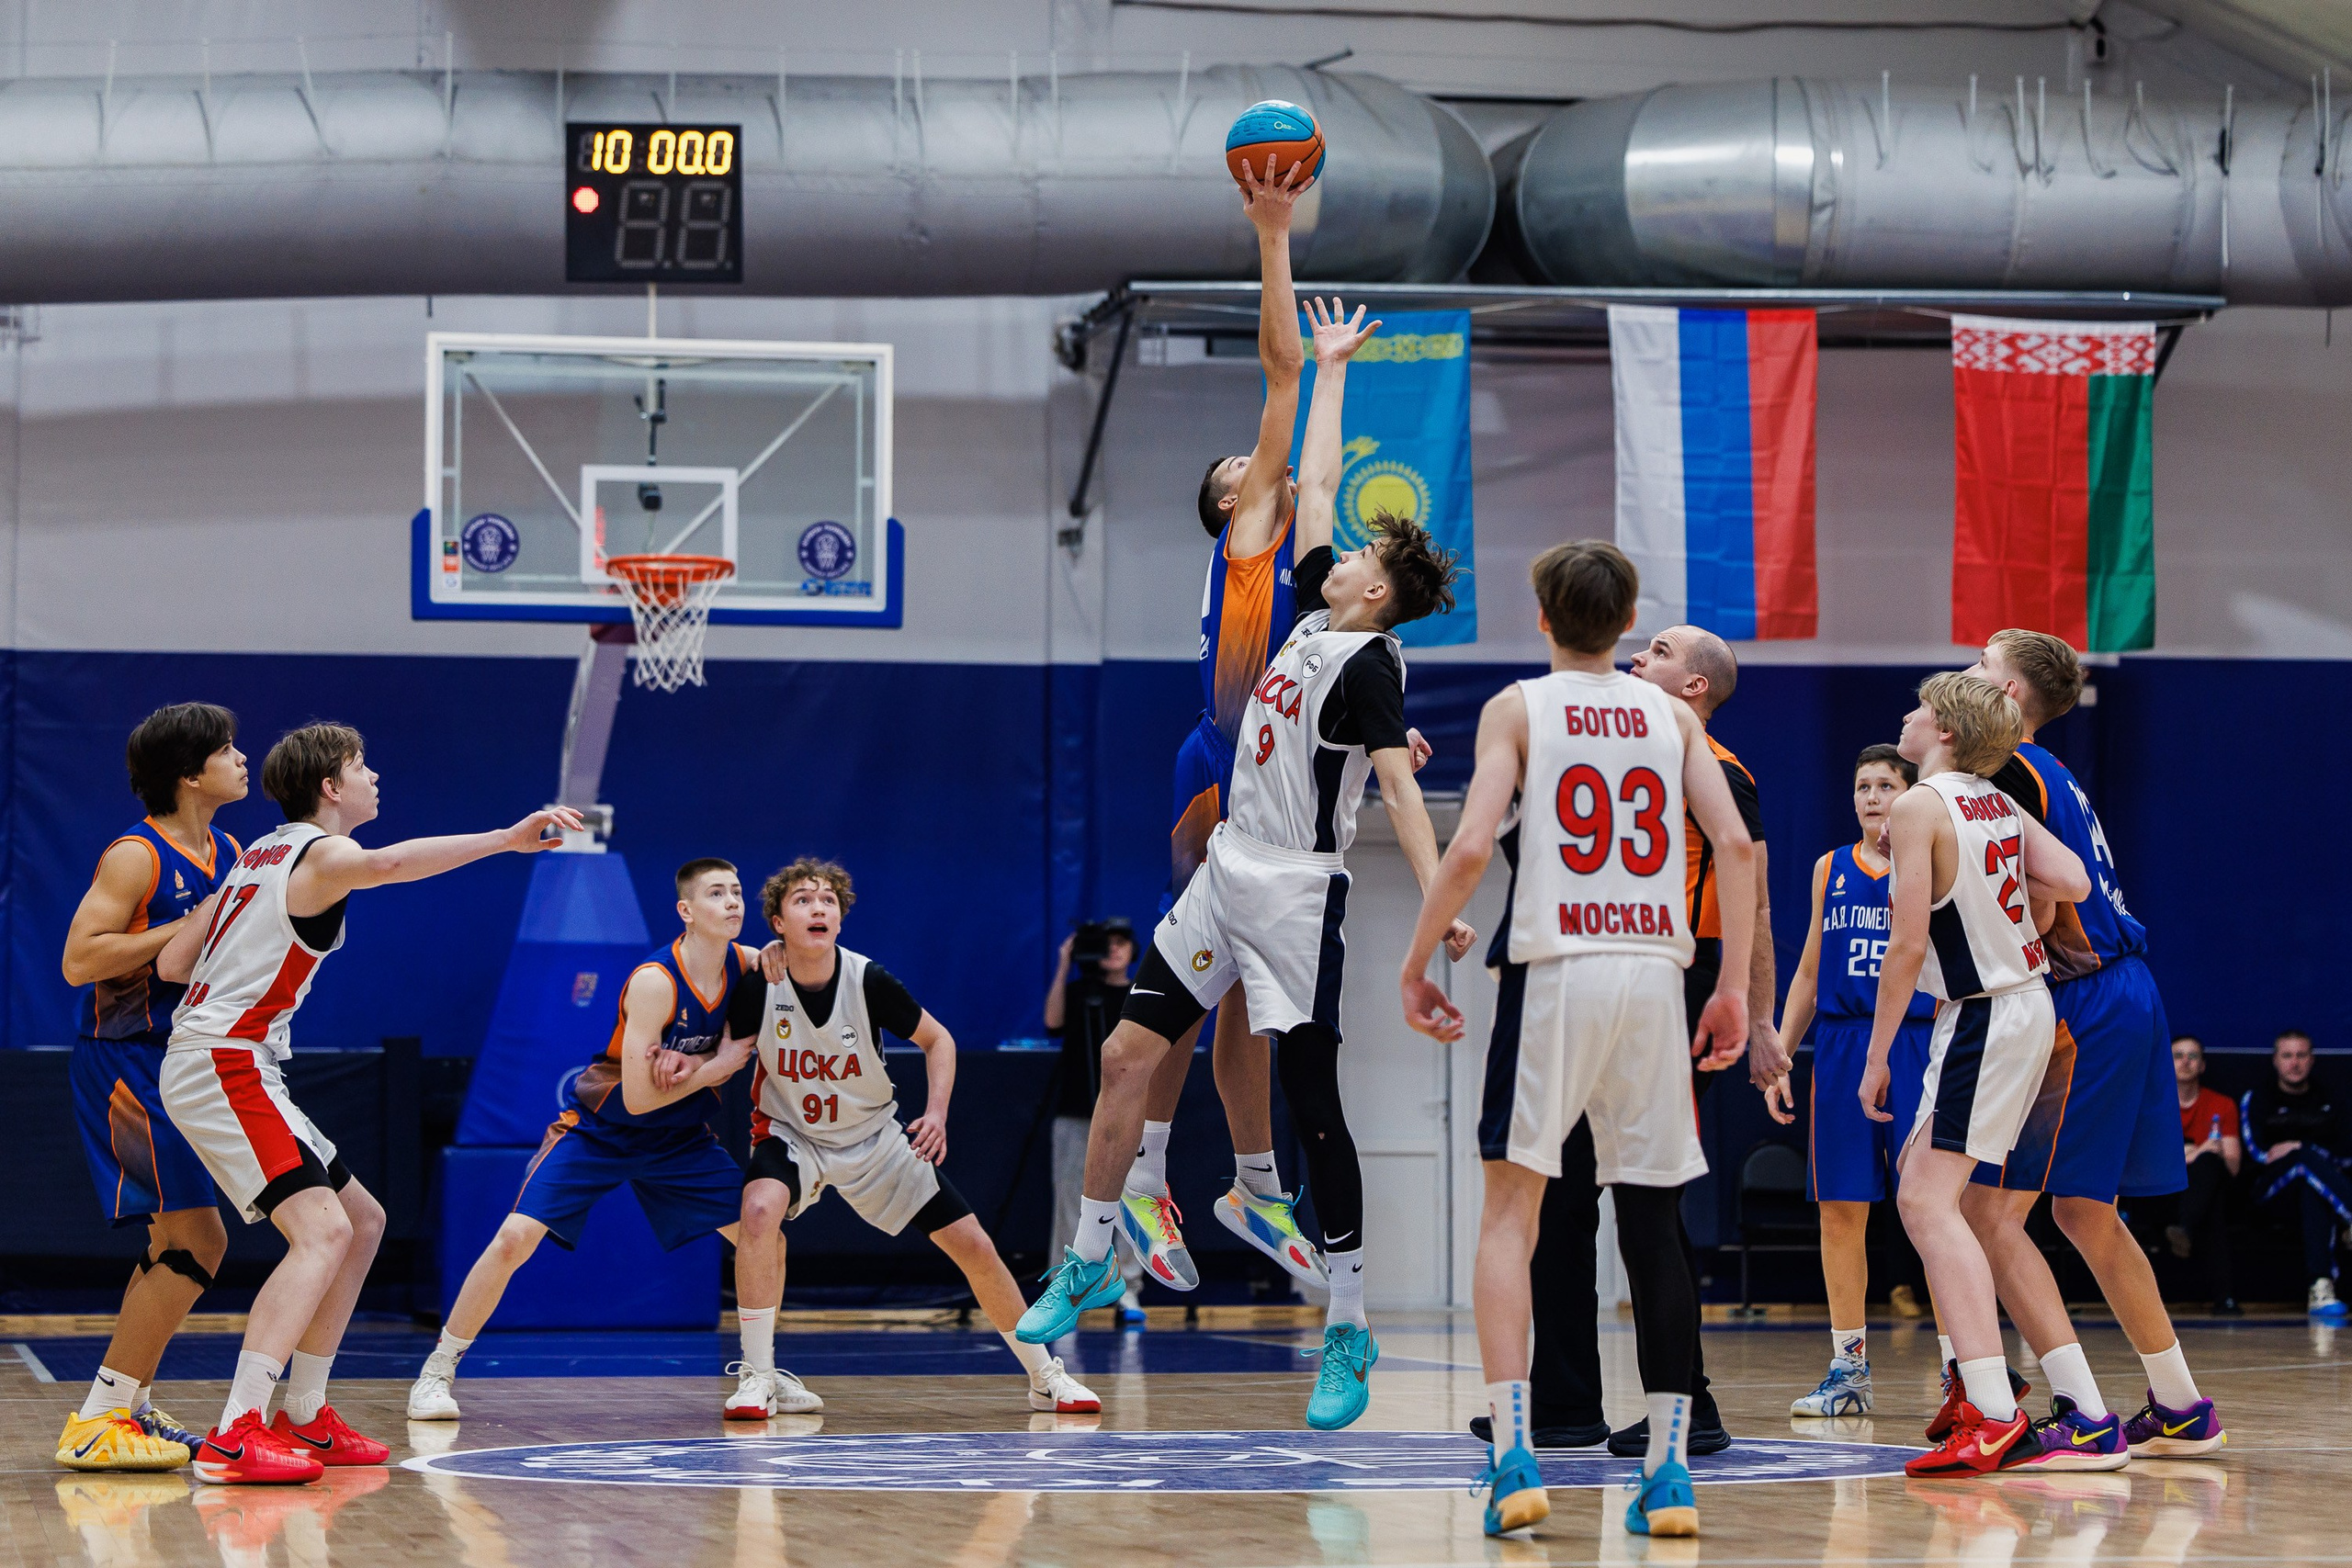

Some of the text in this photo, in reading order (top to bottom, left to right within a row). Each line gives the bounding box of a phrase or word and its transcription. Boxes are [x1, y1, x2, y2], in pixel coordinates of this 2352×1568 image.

[592, 130, 734, 175] 10 00.0
[1305, 660, 1319, 673] РФБ
[1565, 705, 1649, 739] БОГОВ
[1255, 724, 1275, 766] 9
[1555, 763, 1669, 877] 93
[1559, 902, 1675, 937] МОСКВА
[1848, 938, 1890, 977] 25
[777, 1048, 862, 1083] ЦСКА
[802, 1093, 838, 1124] 91
